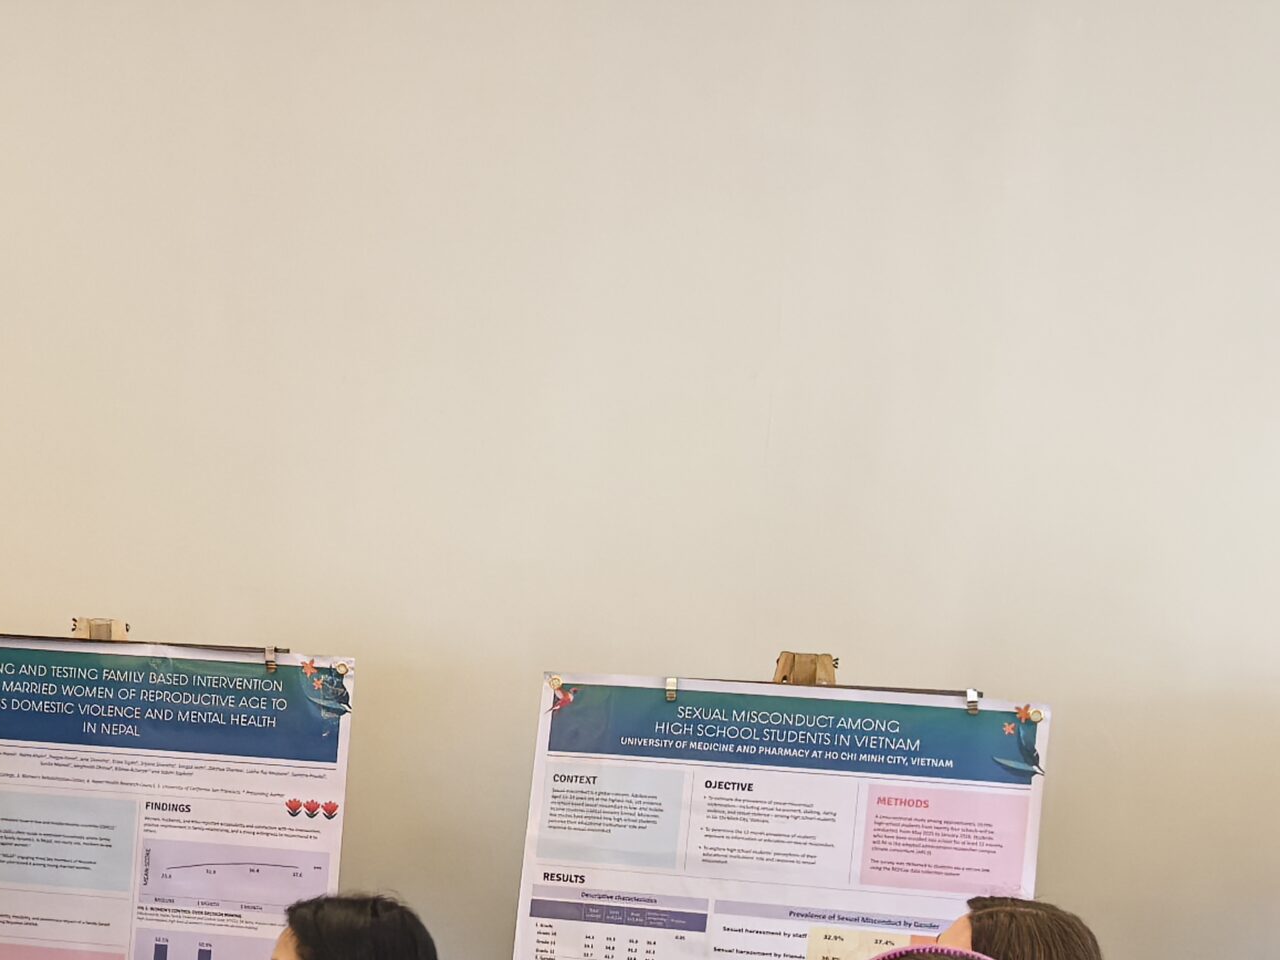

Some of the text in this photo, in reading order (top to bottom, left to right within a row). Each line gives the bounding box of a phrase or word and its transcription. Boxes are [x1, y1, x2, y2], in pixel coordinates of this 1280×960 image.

[19, 664, 47, 677] AND
[51, 666, 98, 680] TESTING
[102, 668, 145, 683] FAMILY
[149, 671, 188, 686] BASED
[192, 675, 283, 692] INTERVENTION
[2, 681, 57, 695] MARRIED
[61, 685, 113, 699] WOMEN
[118, 688, 136, 700] OF
[140, 689, 235, 708] REPRODUCTIVE
[239, 696, 267, 710] AGE
[272, 698, 287, 711] TO
[12, 699, 74, 714] DOMESTIC
[78, 704, 141, 719] VIOLENCE
[145, 708, 173, 721] AND
[177, 711, 226, 725] MENTAL
[230, 714, 276, 728] HEALTH
[677, 706, 900, 733] SEXUAL MISCONDUCT AMONG
[83, 721, 140, 737] IN NEPAL
[655, 722, 921, 751] HIGH SCHOOL STUDENTS IN VIETNAM
[620, 737, 954, 768] UNIVERSITY OF MEDICINE AND PHARMACY AT HO CHI MINH CITY, VIETNAM
[553, 773, 598, 785] CONTEXT
[704, 780, 754, 791] OJECTIVE
[145, 801, 191, 813] FINDINGS
[876, 796, 930, 808] METHODS
[543, 872, 586, 884] RESULTS
[789, 910, 825, 921] Prevalence
[837, 914, 860, 923] Sexual
[861, 916, 902, 927] Misconduct
[903, 920, 912, 928] by
[913, 921, 940, 930] Gender
